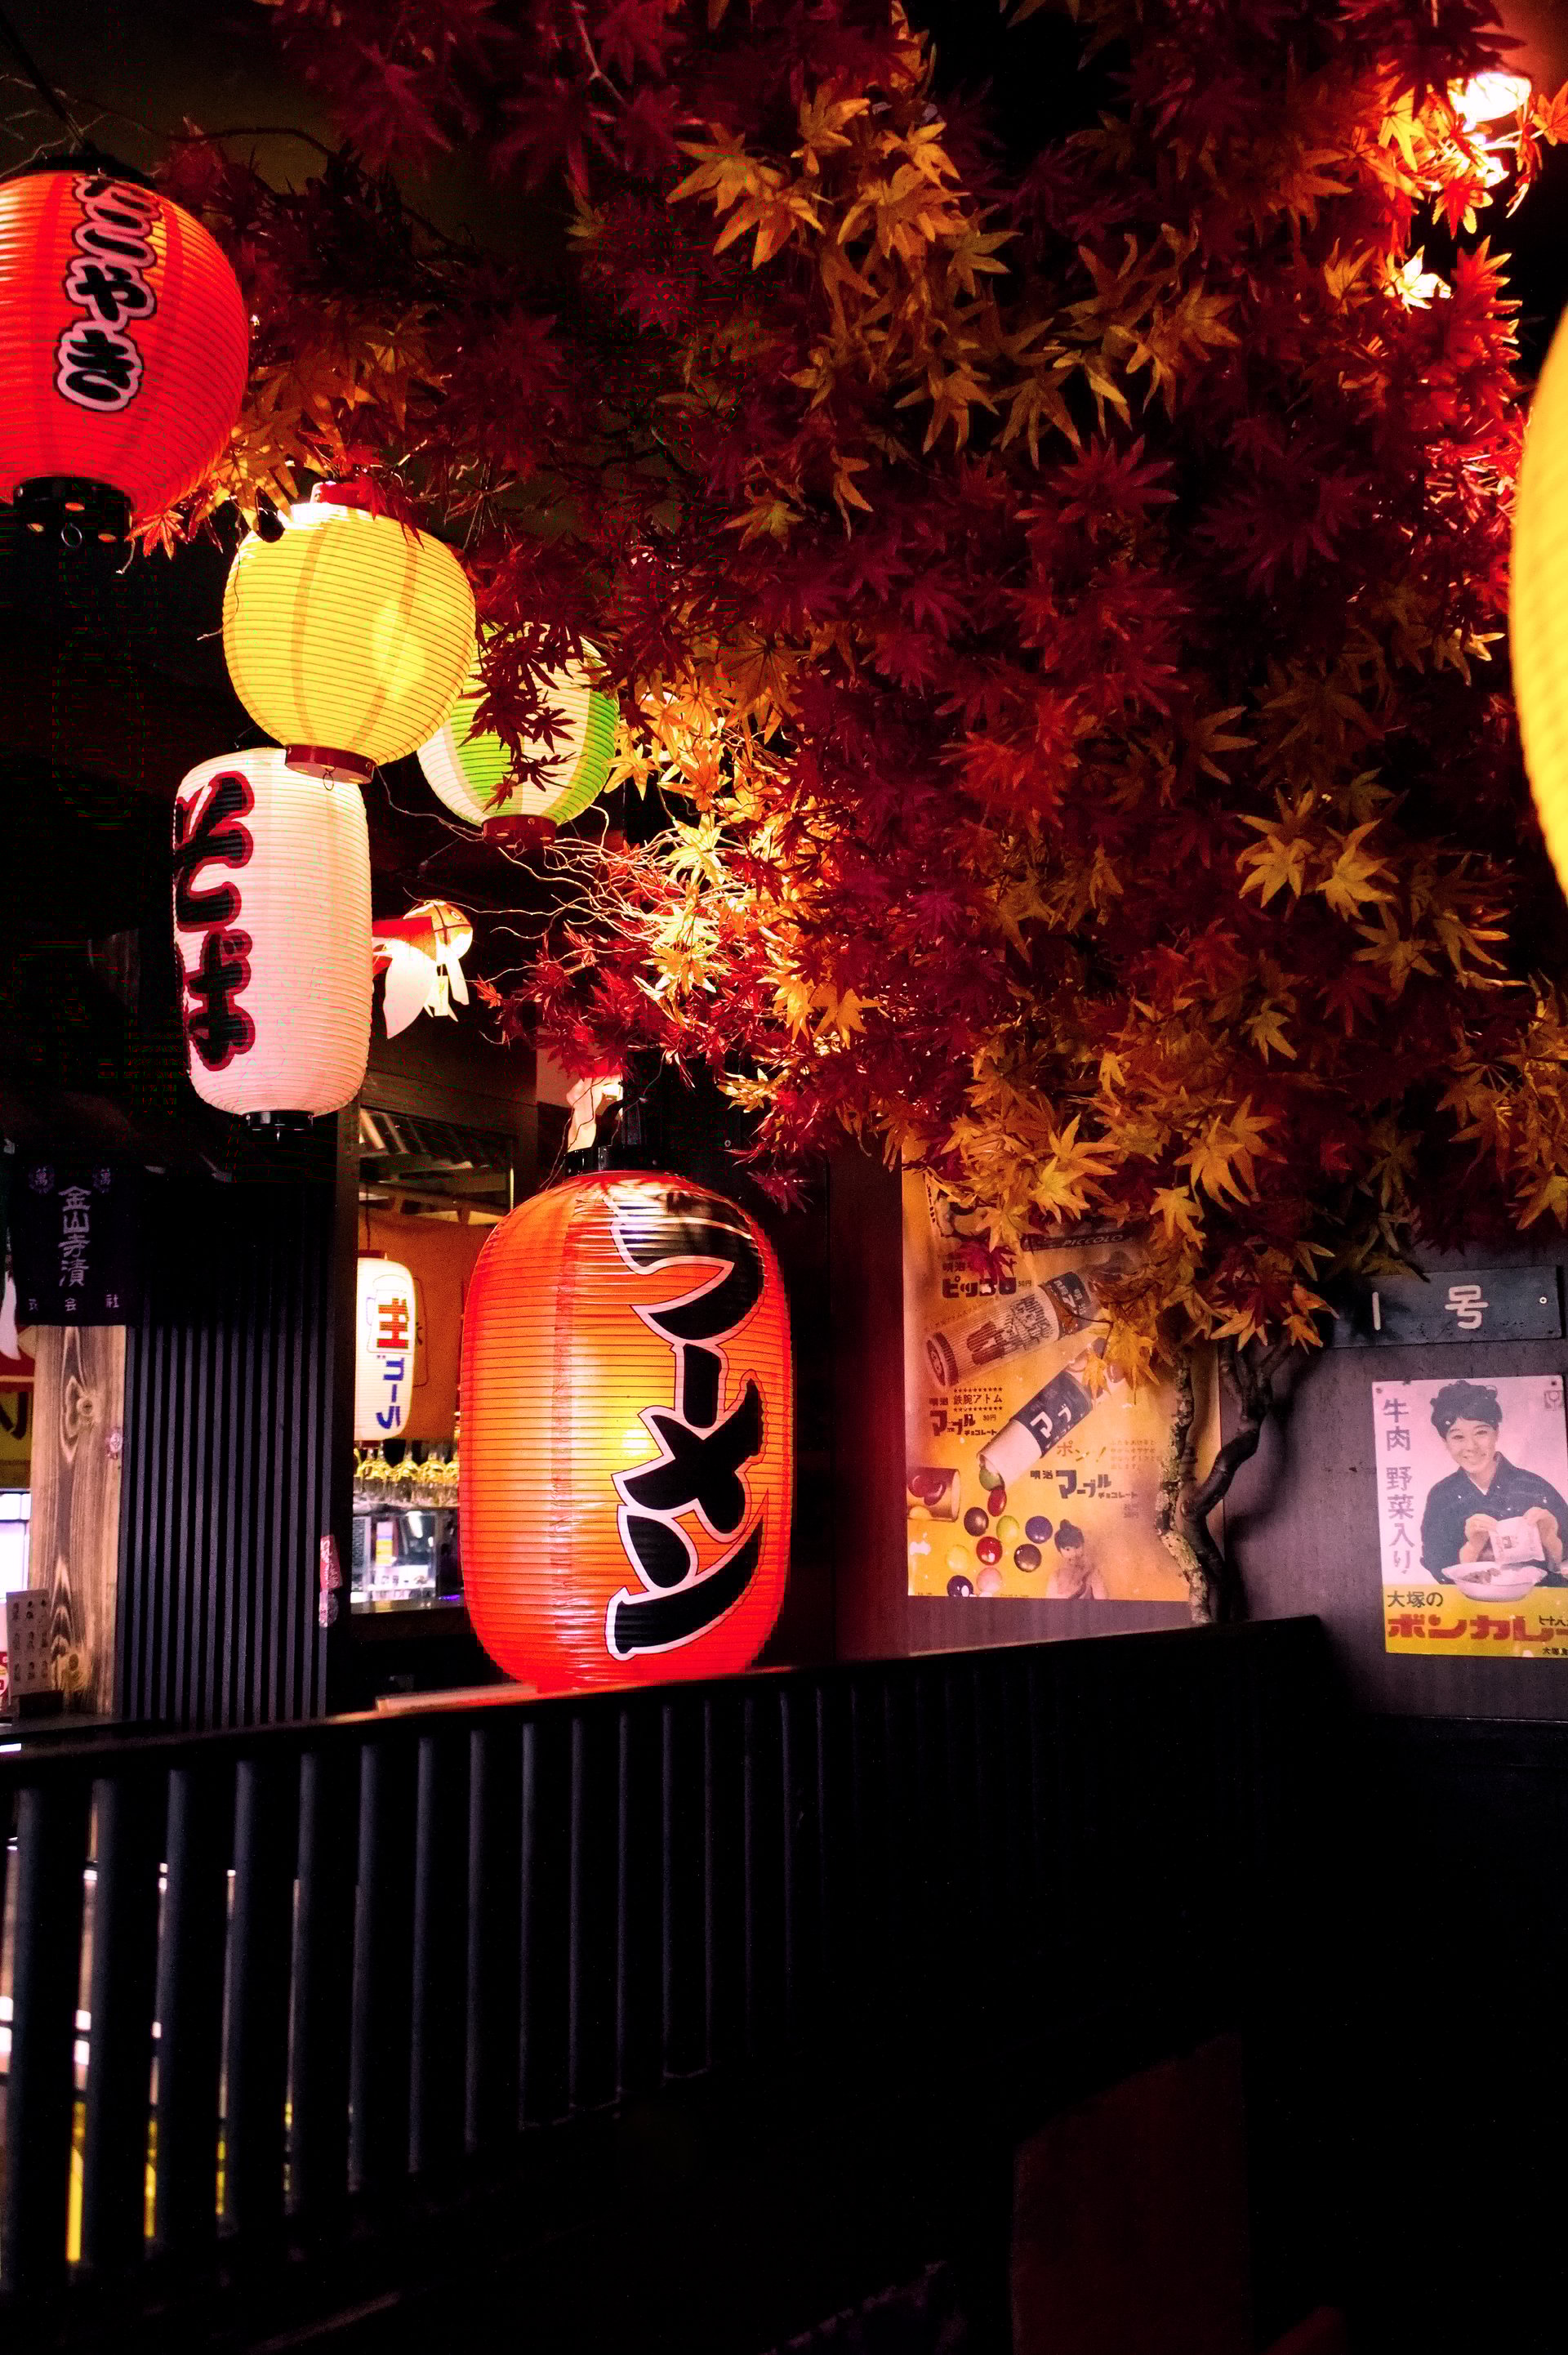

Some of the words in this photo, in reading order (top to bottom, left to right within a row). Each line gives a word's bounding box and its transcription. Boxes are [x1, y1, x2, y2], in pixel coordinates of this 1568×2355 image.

[1063, 1234, 1125, 1247] PICCOLO
[953, 1394, 1003, 1406] 鉄腕アトム
[605, 1190, 768, 1660] ラーメン
[1383, 1398, 1411, 1452] 牛肉
[1388, 1590, 1444, 1608] 大塚の
[1388, 1613, 1568, 1642] ボンカレー
